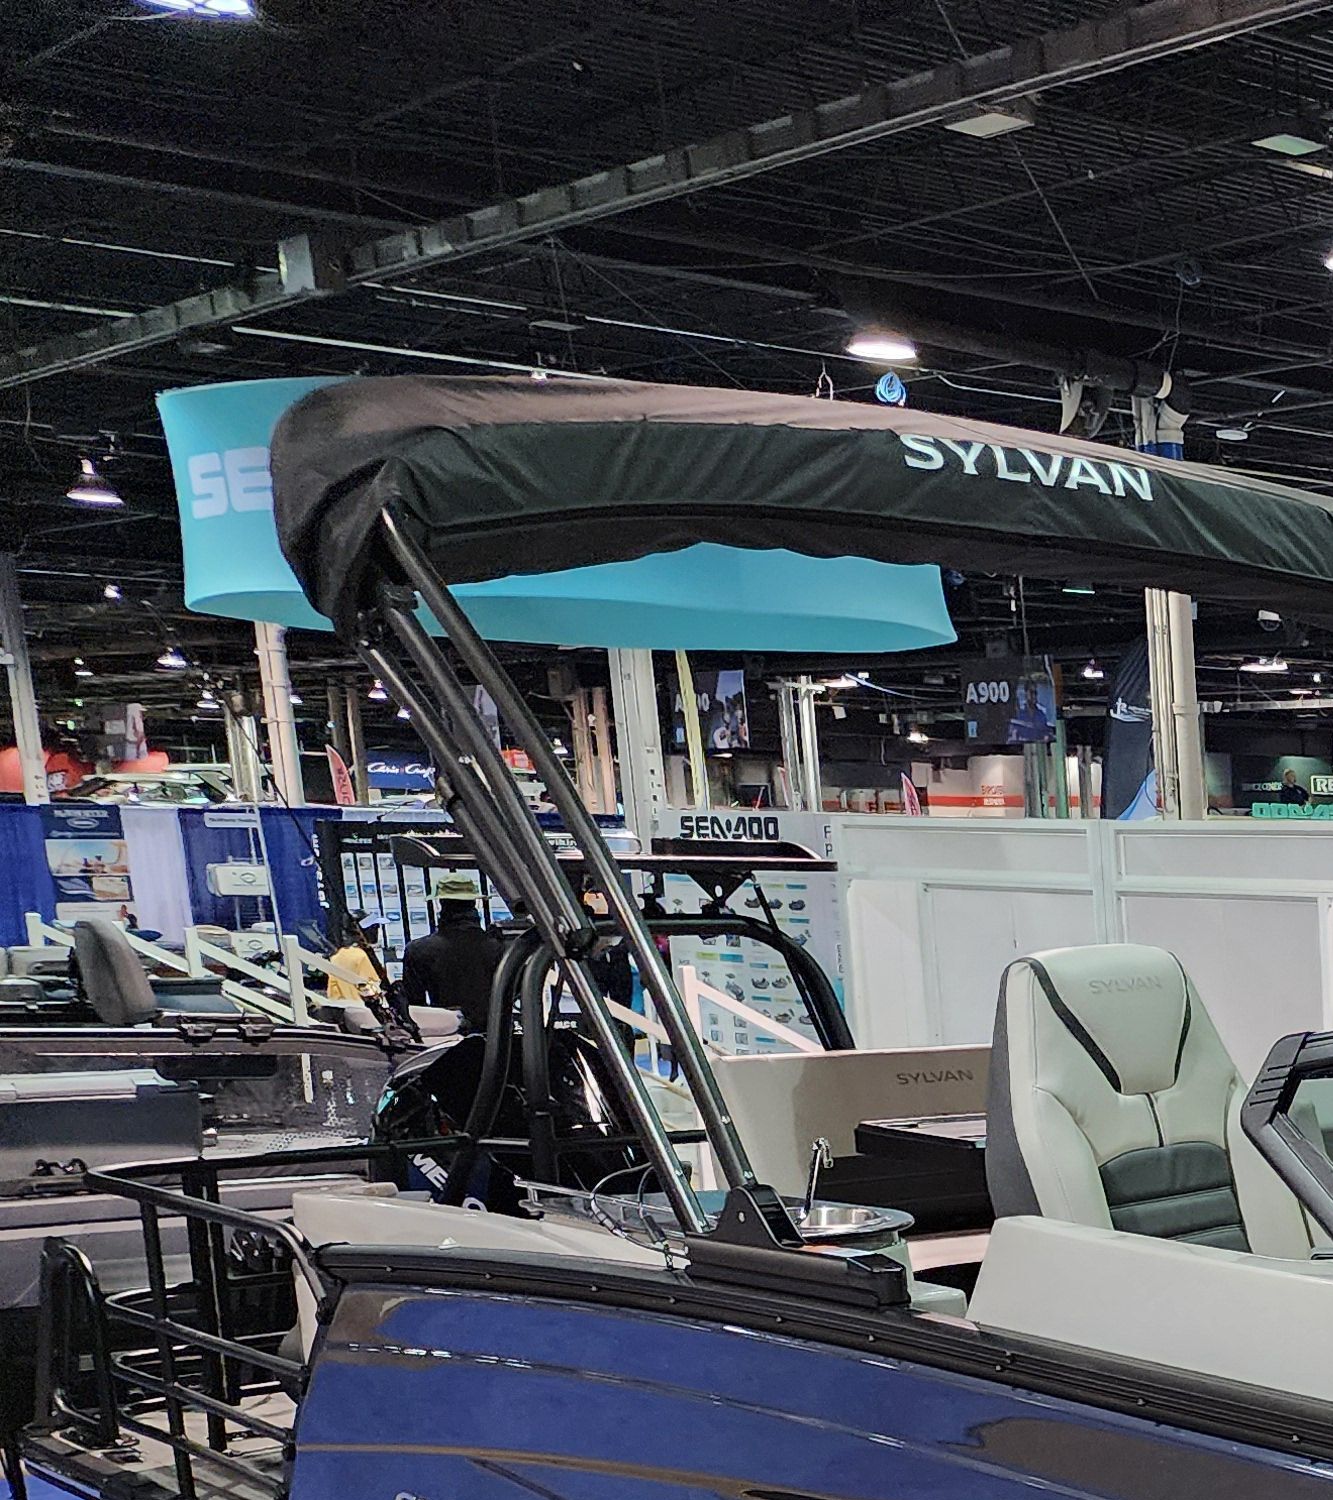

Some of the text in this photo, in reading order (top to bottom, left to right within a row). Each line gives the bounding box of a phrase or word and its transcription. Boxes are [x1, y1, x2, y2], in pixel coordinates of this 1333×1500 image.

[901, 434, 1154, 501] SYLVAN
[966, 681, 1010, 703] A900
[1088, 976, 1163, 994] SYLVAN
[896, 1069, 974, 1085] SYLVAN
